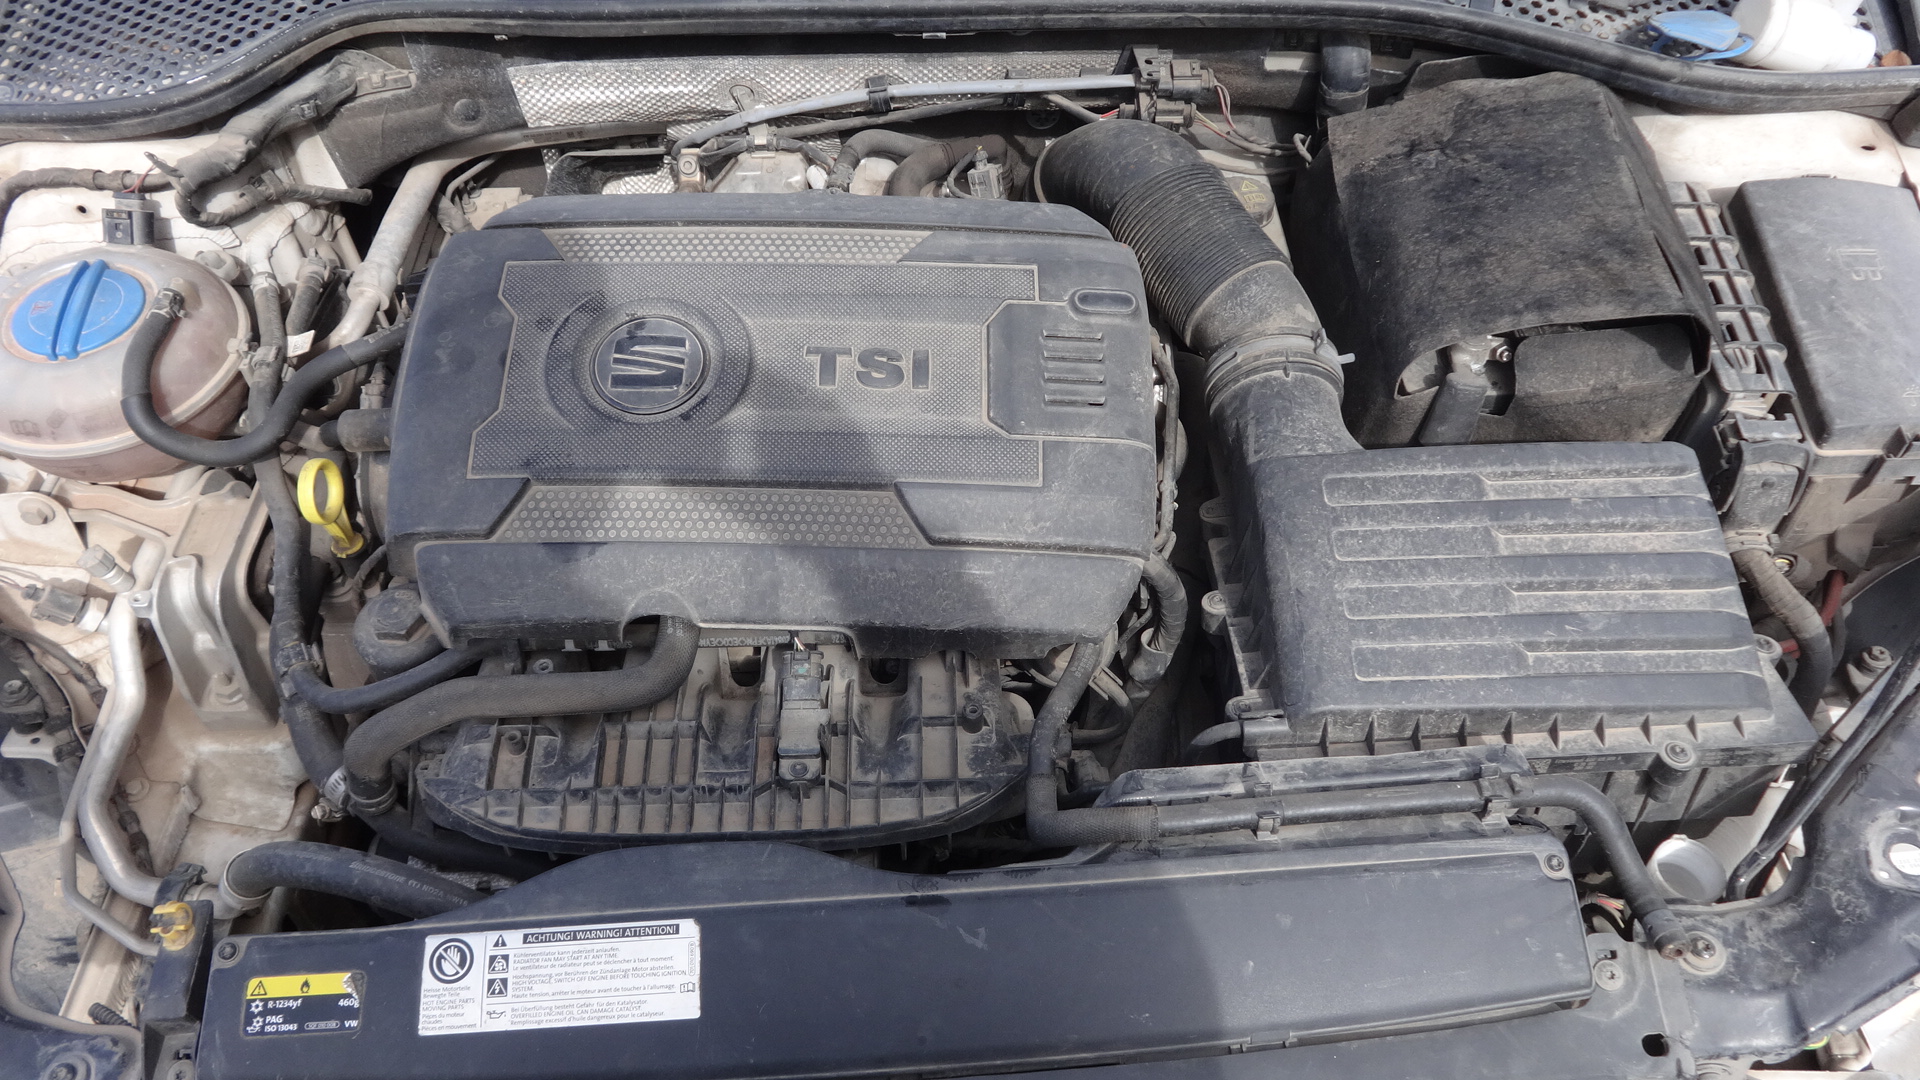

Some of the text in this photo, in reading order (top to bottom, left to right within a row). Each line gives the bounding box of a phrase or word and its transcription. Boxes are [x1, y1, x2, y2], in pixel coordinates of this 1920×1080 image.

[803, 345, 931, 391] TSI
[525, 925, 676, 942] ACHTUNG! WARNING! ATTENTION!
[513, 950, 556, 958] Kühlerventilator
[571, 948, 594, 956] jederzeit
[599, 966, 630, 974] Zündanlage
[267, 998, 360, 1010] R-1234yf 460g
[520, 1003, 553, 1013] Überfüllung
[265, 1014, 284, 1024] PAG
[509, 1018, 543, 1026] Remplissage
[586, 1013, 615, 1021] dangereux
[510, 1011, 542, 1019] OVERFILLED
[278, 1023, 298, 1032] 13043
[344, 1020, 359, 1028] VW
